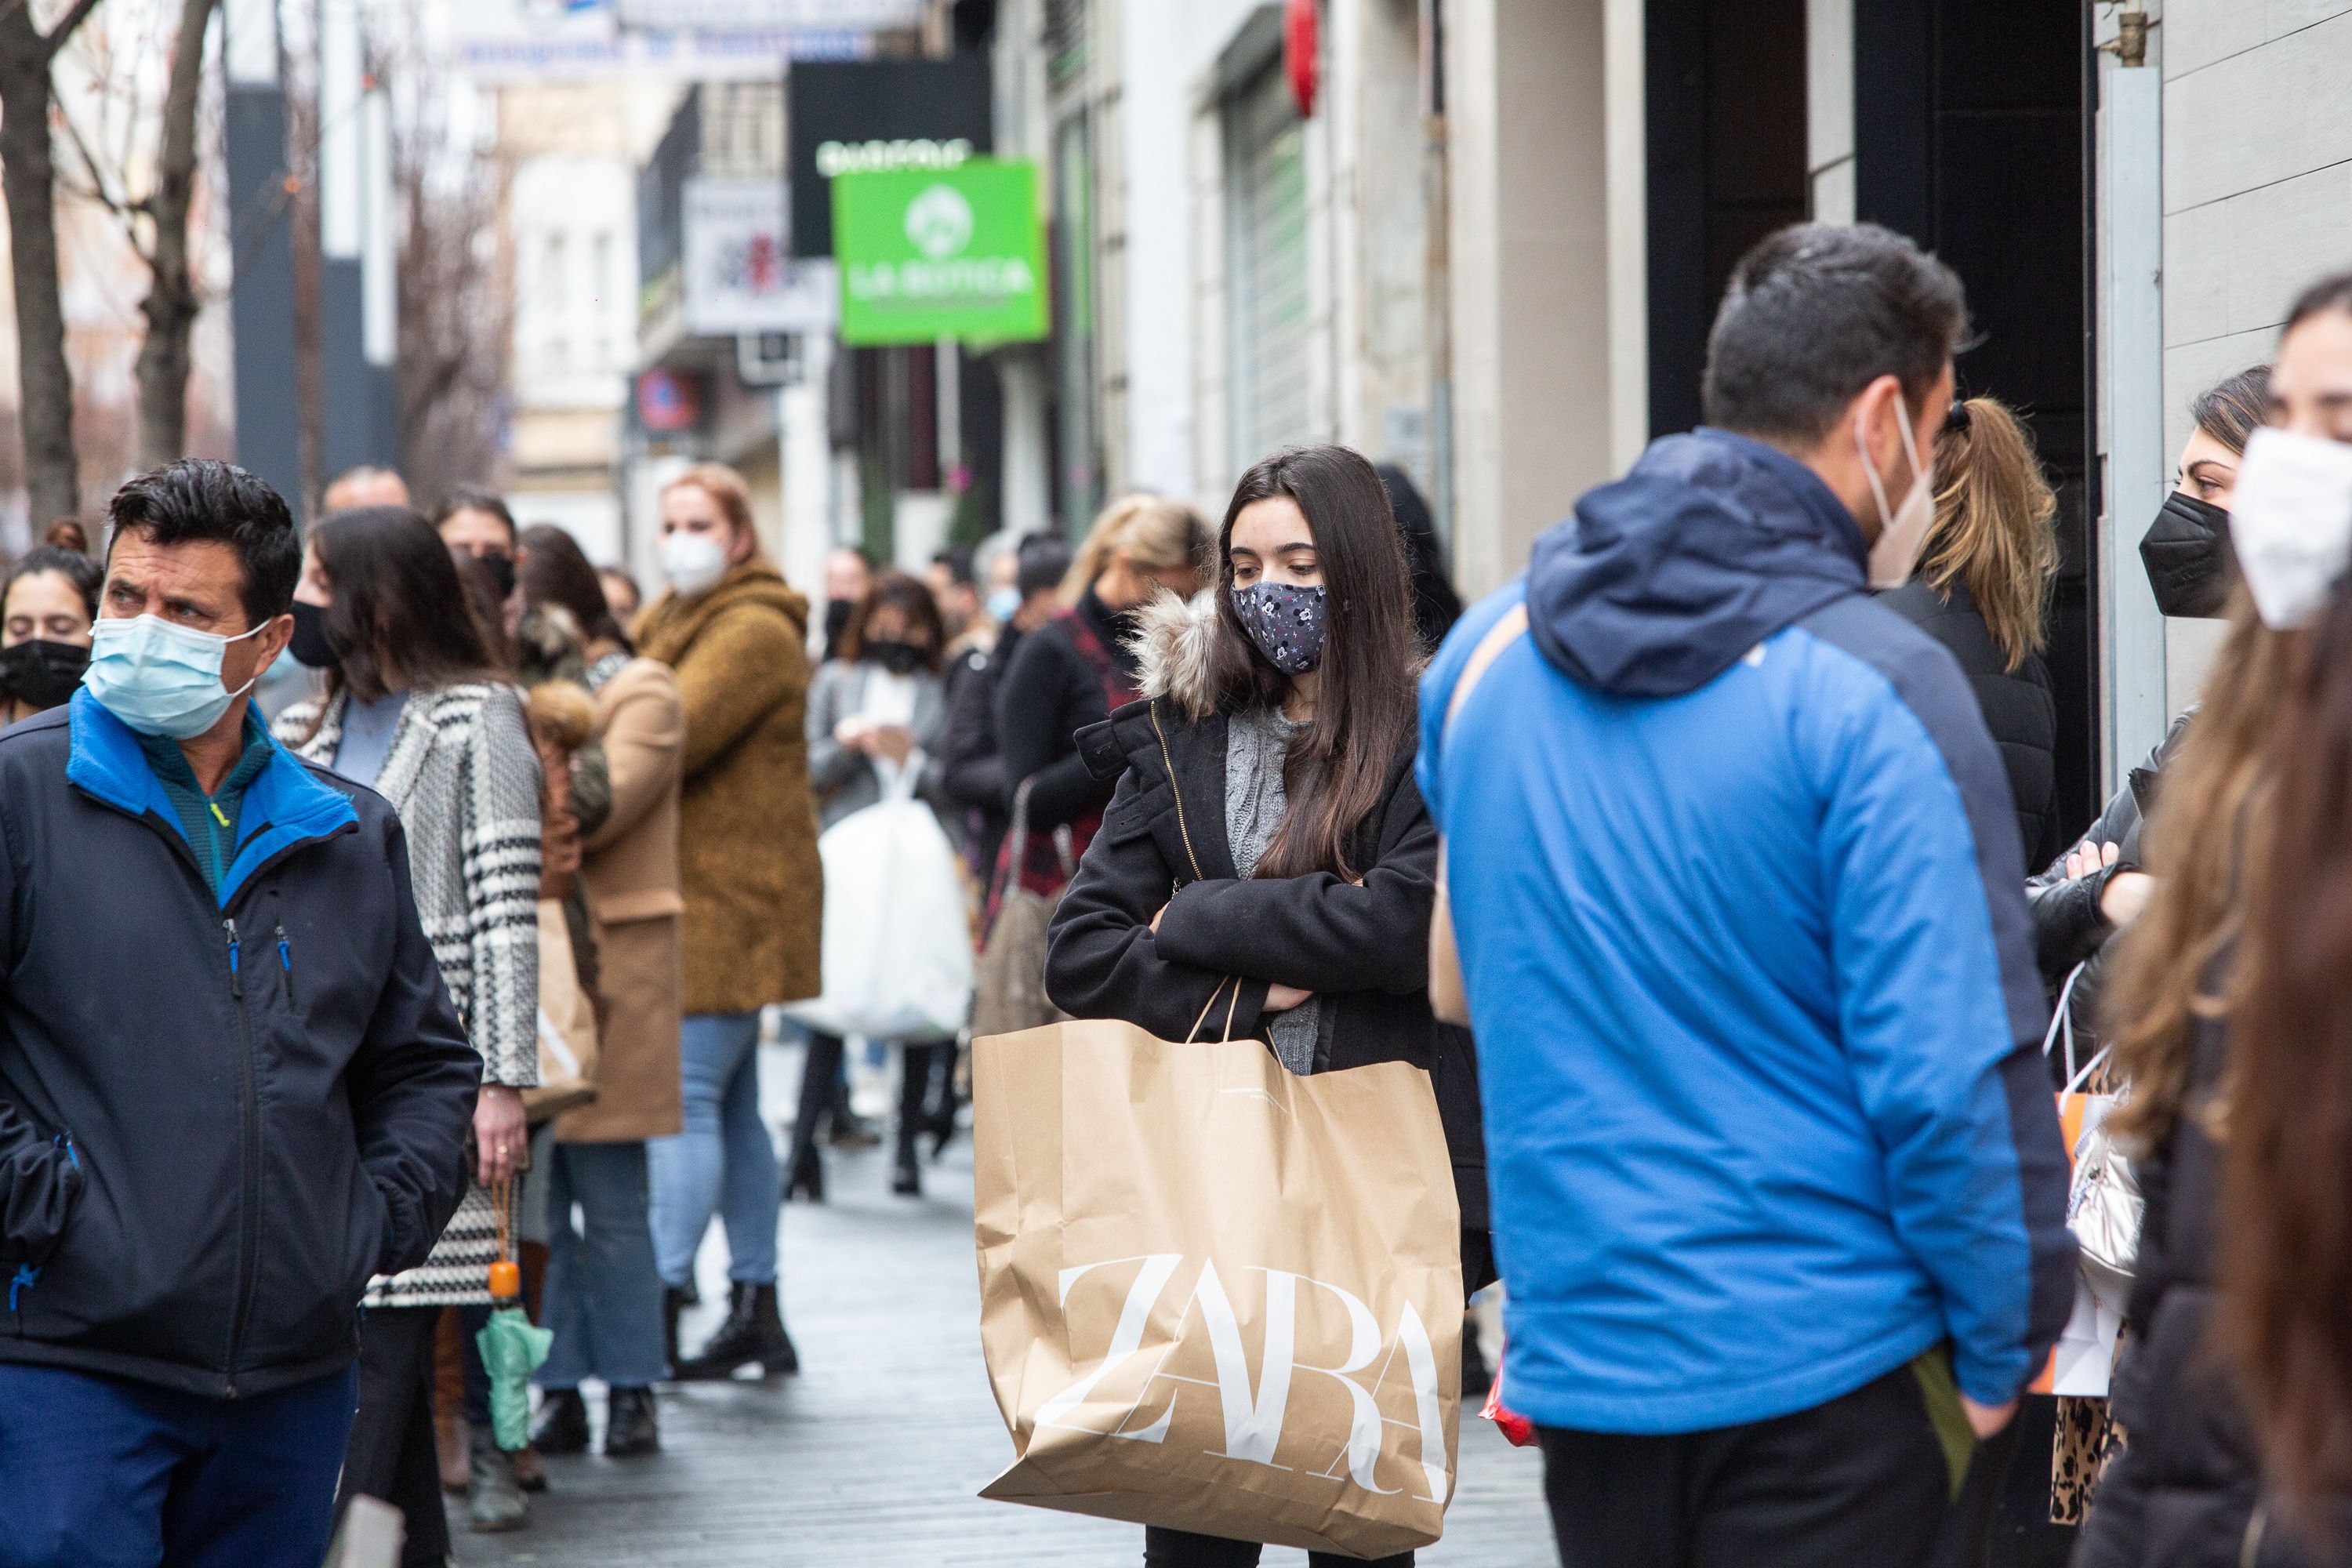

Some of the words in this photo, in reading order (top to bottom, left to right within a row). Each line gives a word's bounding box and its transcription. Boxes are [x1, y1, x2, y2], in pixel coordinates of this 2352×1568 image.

[849, 262, 895, 299] LA
[901, 257, 1034, 298] BOTICA
[1033, 1254, 1448, 1504] ZARA
